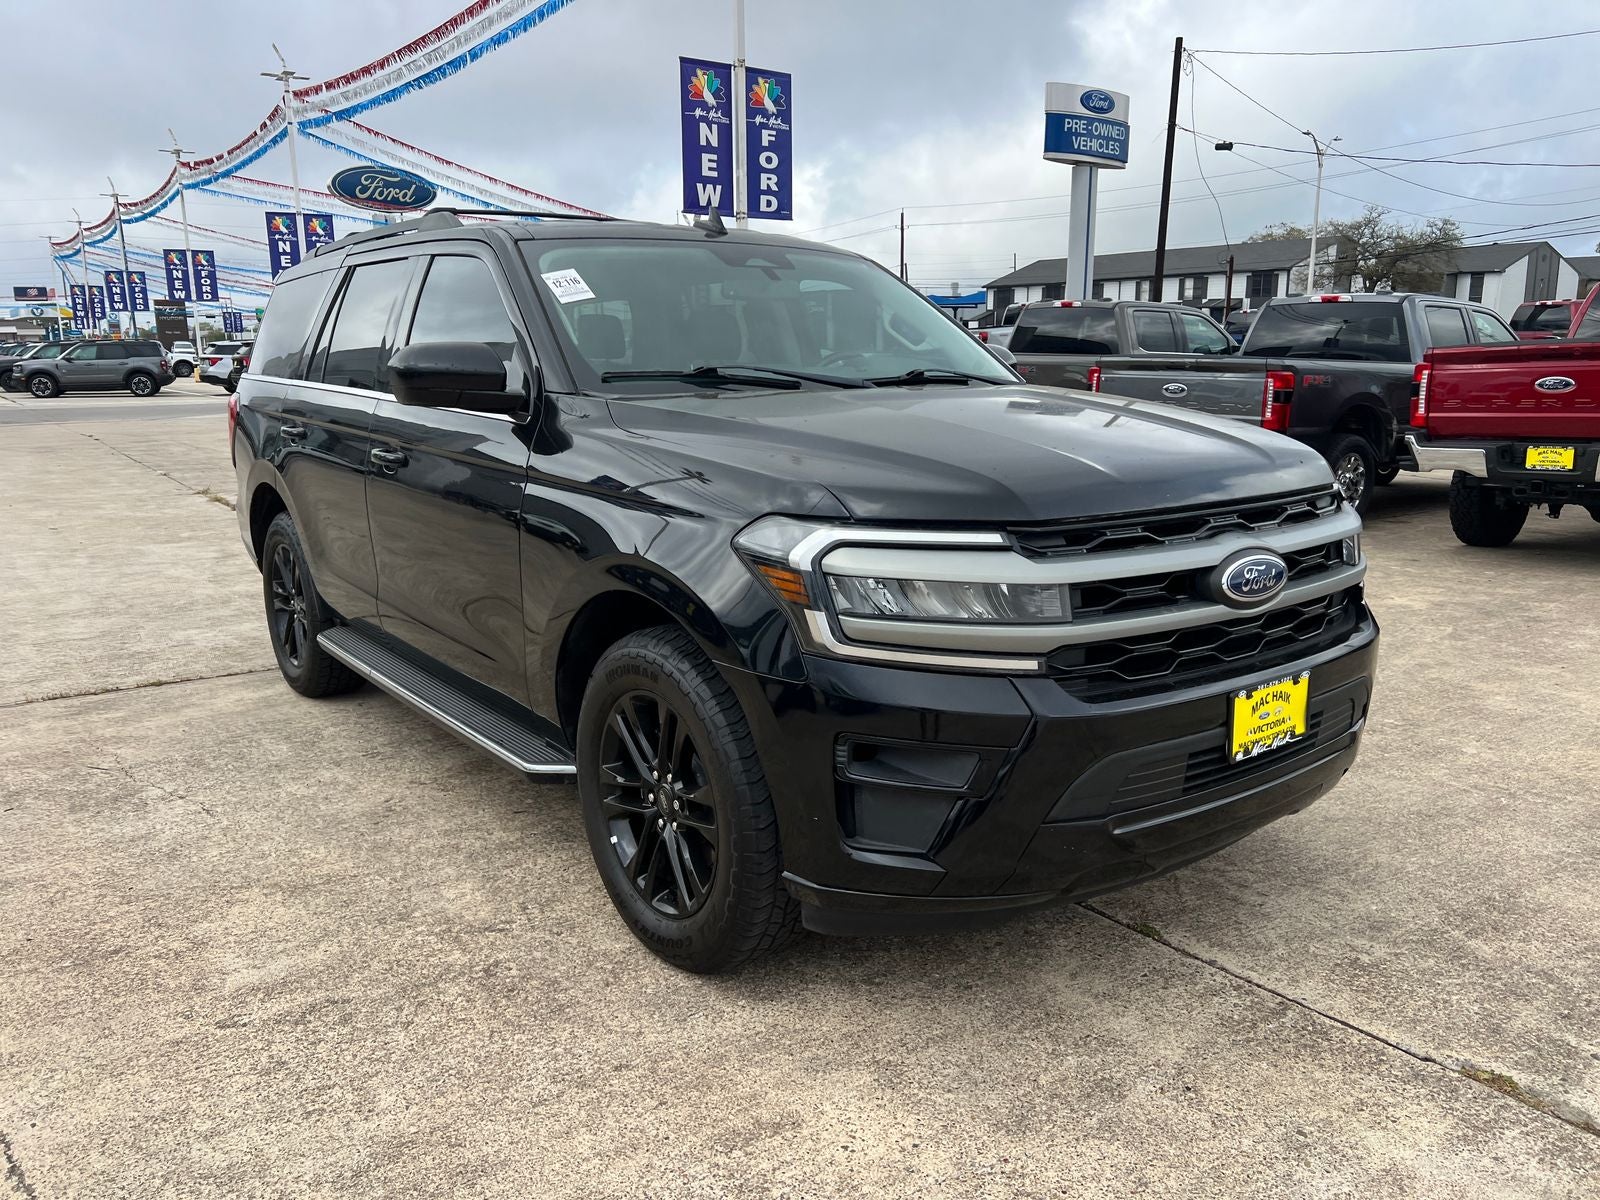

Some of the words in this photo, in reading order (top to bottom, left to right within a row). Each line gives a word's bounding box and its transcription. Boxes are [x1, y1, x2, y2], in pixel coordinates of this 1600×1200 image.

[1088, 93, 1109, 109] Ford
[1072, 136, 1120, 155] VEHICLES
[696, 122, 722, 208] NEW
[759, 129, 779, 212] FORD
[355, 173, 416, 203] Ford
[172, 270, 186, 299] NEW
[200, 270, 212, 300] FORD
[75, 298, 84, 316] NEW
[112, 287, 123, 310] NEW
[135, 287, 144, 310] FORD
[1241, 565, 1276, 592] Ford
[1251, 692, 1271, 717] MAC
[1271, 690, 1291, 704] HAIK
[1252, 716, 1286, 735] VICTORIA
[1248, 742, 1271, 757] Mac
